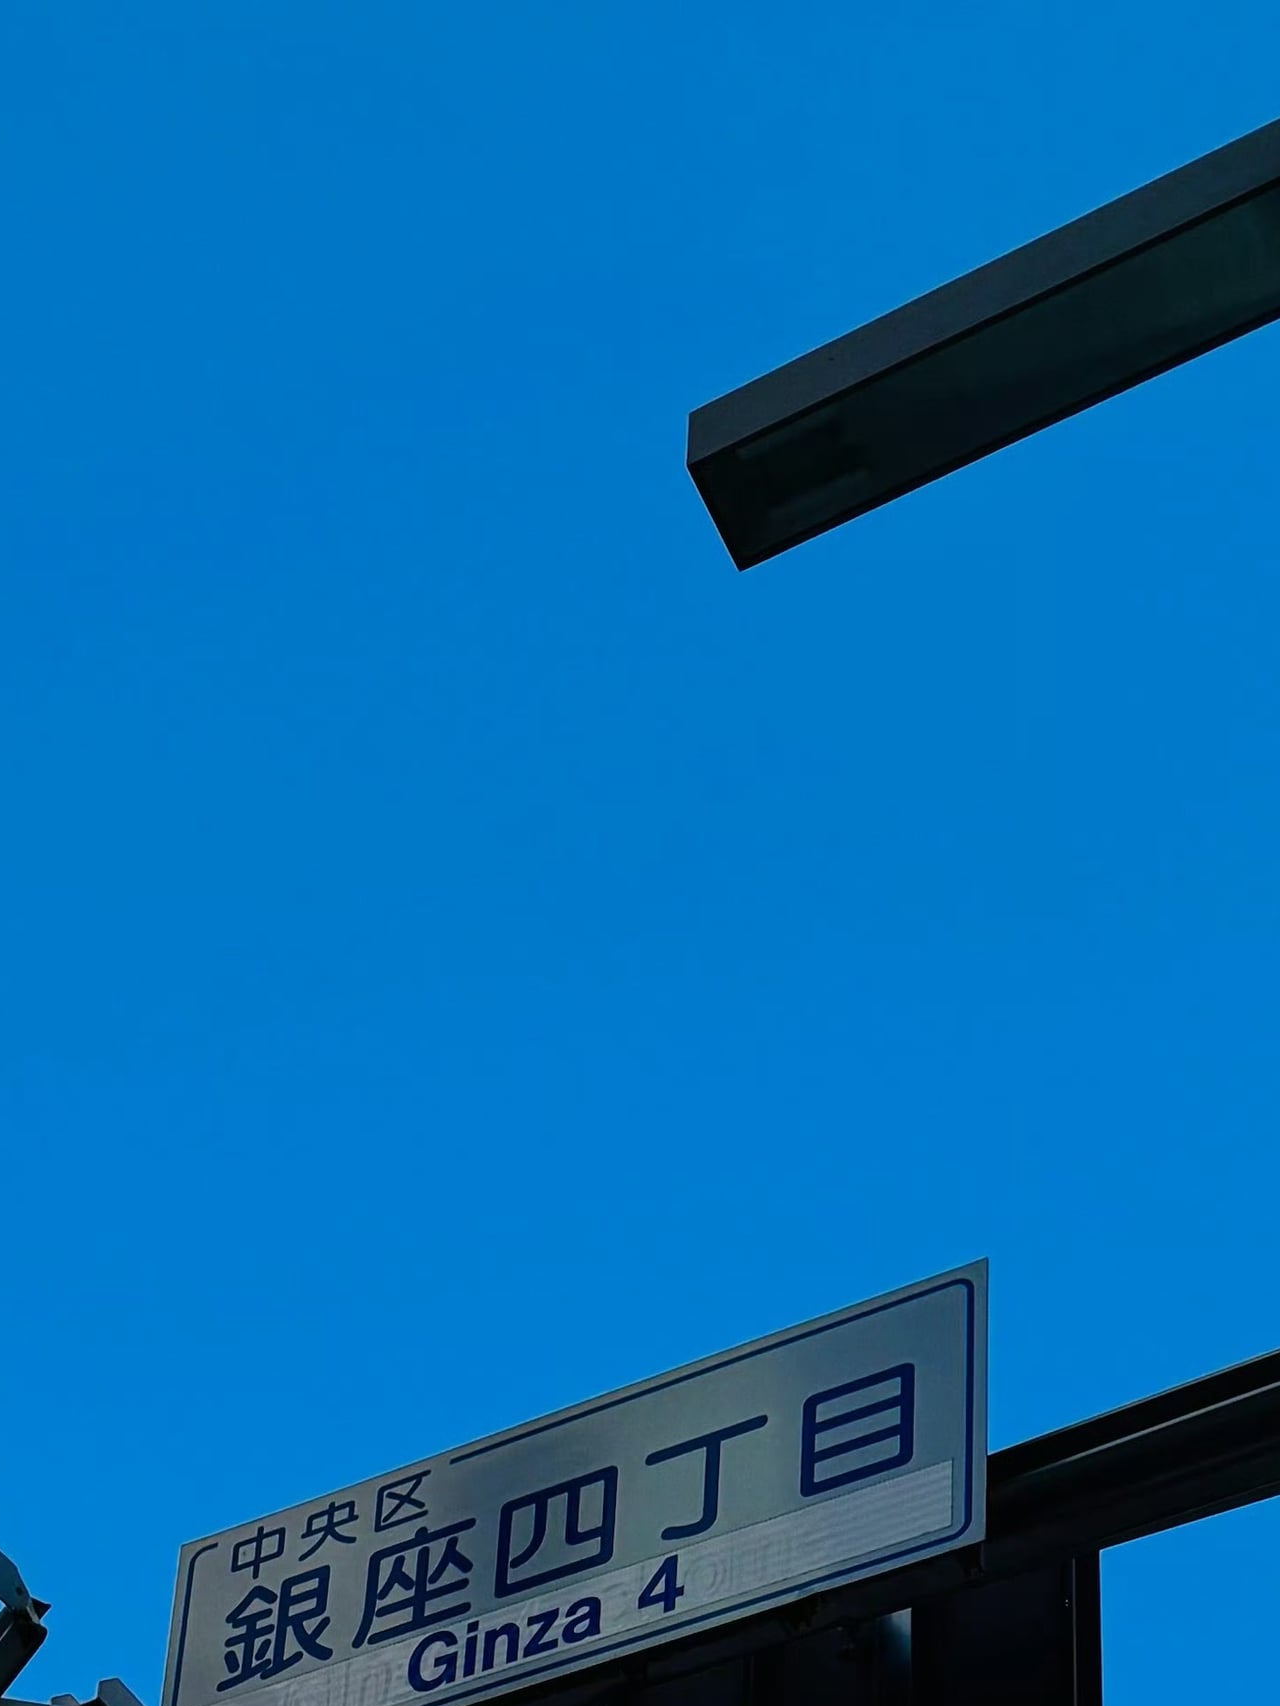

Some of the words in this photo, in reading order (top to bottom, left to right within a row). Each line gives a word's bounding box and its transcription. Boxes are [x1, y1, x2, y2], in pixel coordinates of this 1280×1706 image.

[217, 1362, 916, 1693] 銀座四丁目
[230, 1469, 432, 1579] 中央区
[407, 1596, 601, 1694] Ginza
[638, 1555, 685, 1612] 4
